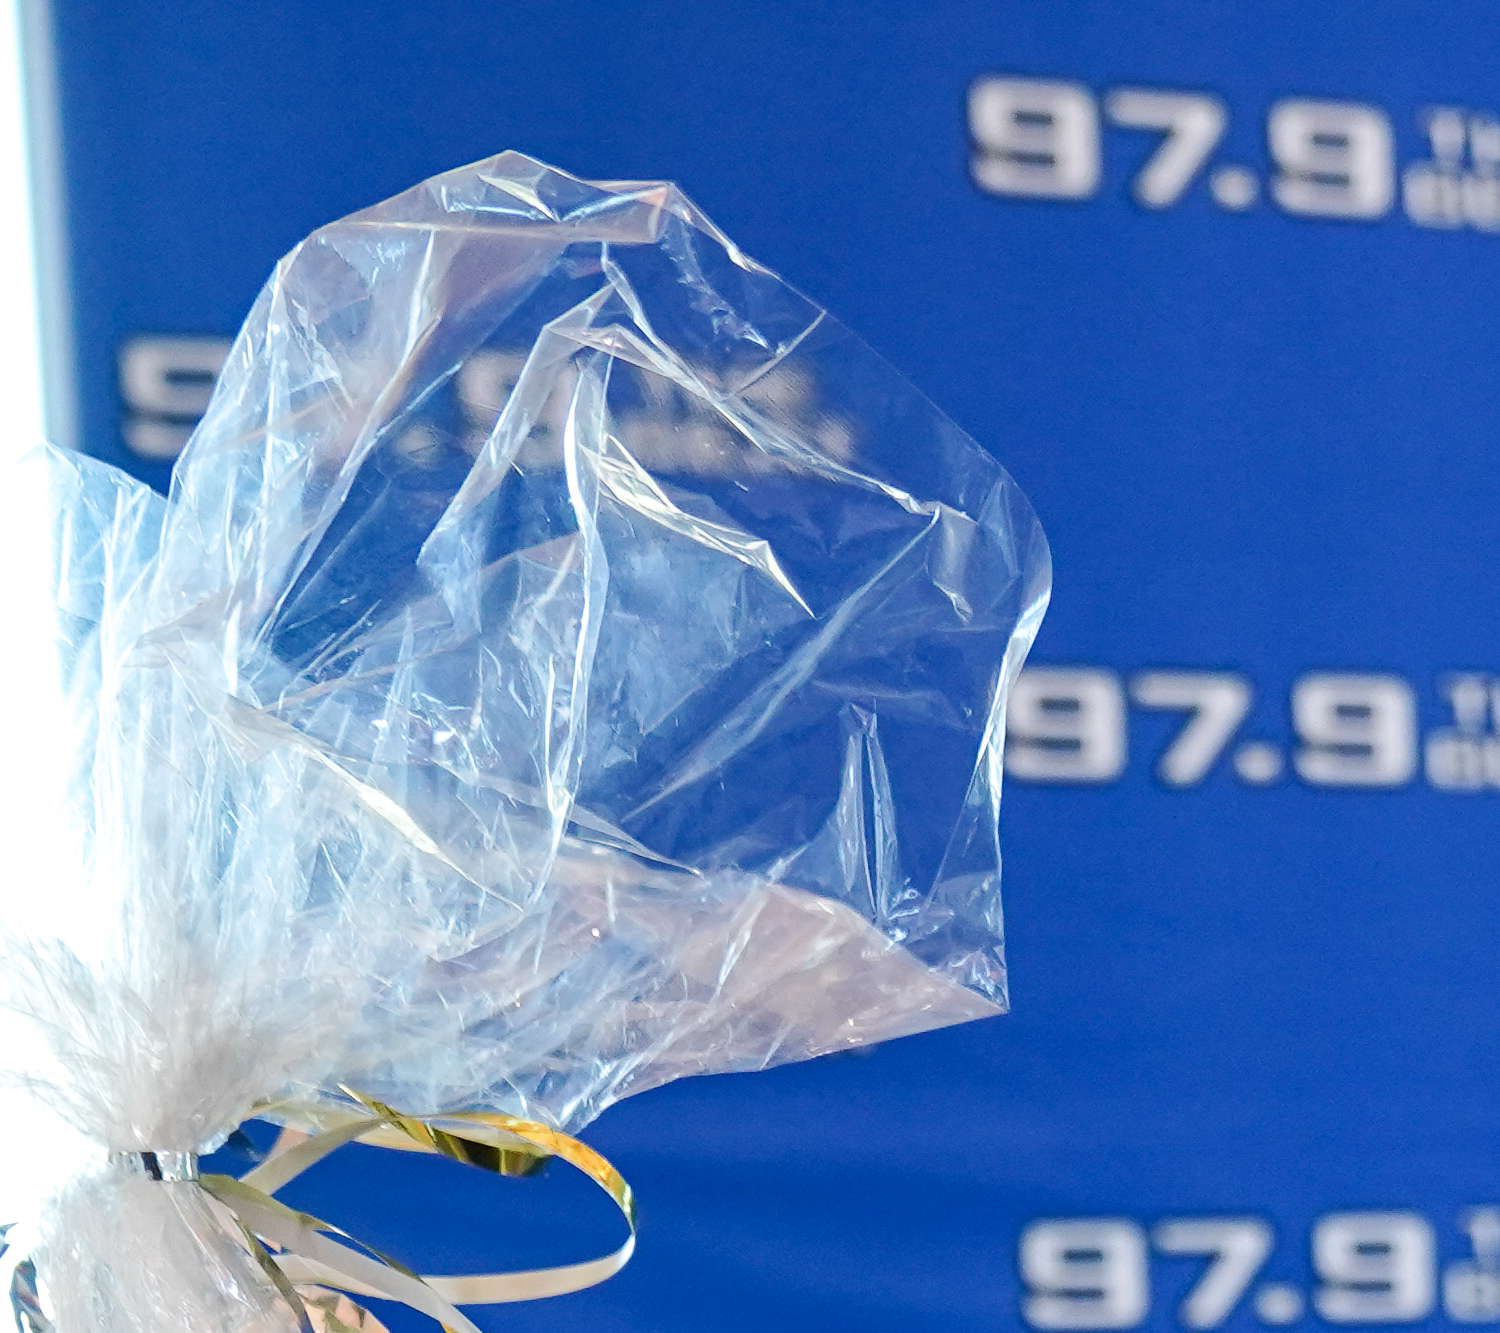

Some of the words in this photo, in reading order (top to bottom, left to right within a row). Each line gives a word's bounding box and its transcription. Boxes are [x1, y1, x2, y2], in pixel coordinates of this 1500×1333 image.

[969, 78, 1396, 222] 97.9
[1004, 668, 1418, 790] 97.9
[1018, 1211, 1440, 1331] 97.9
